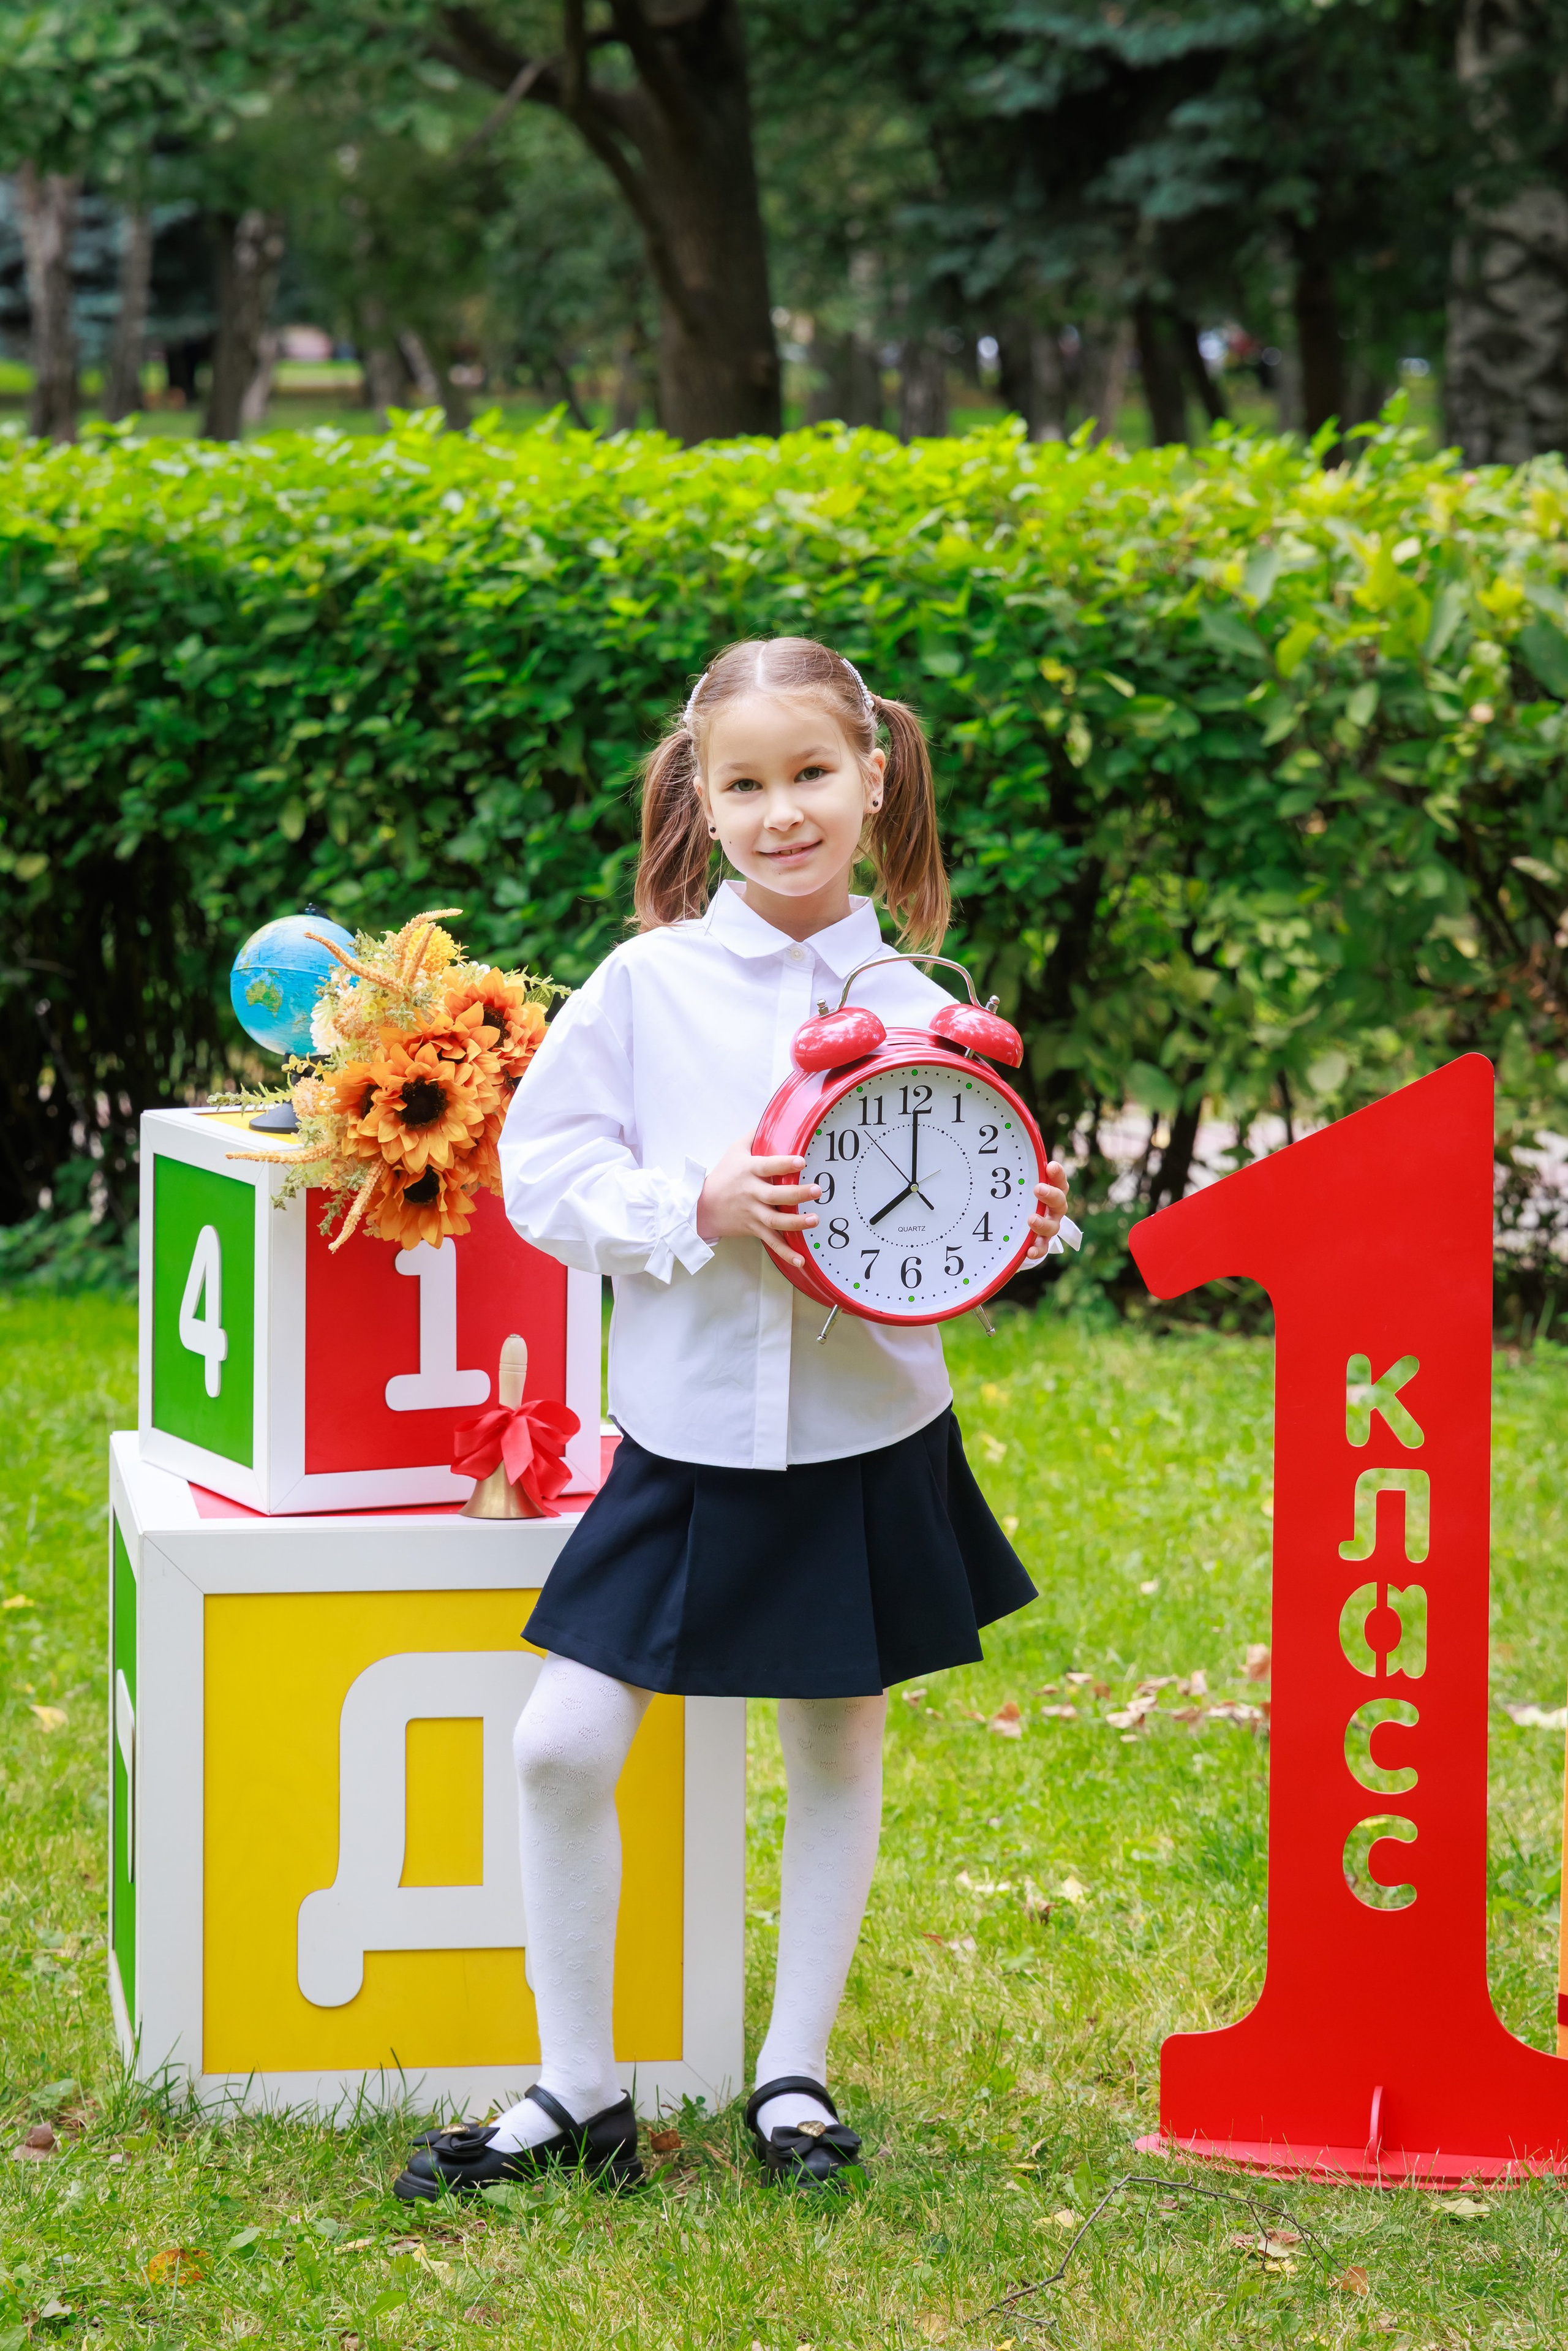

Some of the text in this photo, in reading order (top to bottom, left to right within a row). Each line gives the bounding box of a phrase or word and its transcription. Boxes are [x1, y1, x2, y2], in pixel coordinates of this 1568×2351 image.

[858, 1095, 887, 1126] 11
[898, 1085, 933, 1115] 12
[951, 1093, 965, 1123] 1
[825, 1130, 860, 1161] 10
[978, 1125, 998, 1154] 2
[813, 1172, 835, 1204] 9
[990, 1167, 1011, 1199] 3
[827, 1217, 850, 1249] 8
[972, 1211, 993, 1242] 4
[861, 1249, 881, 1280] 7
[900, 1256, 922, 1289] 6
[944, 1245, 964, 1276] 5
[179, 1225, 228, 1398] 4
[385, 1236, 491, 1411] 1
[1128, 1052, 1568, 2160] 1
[297, 1650, 546, 2007] Д
